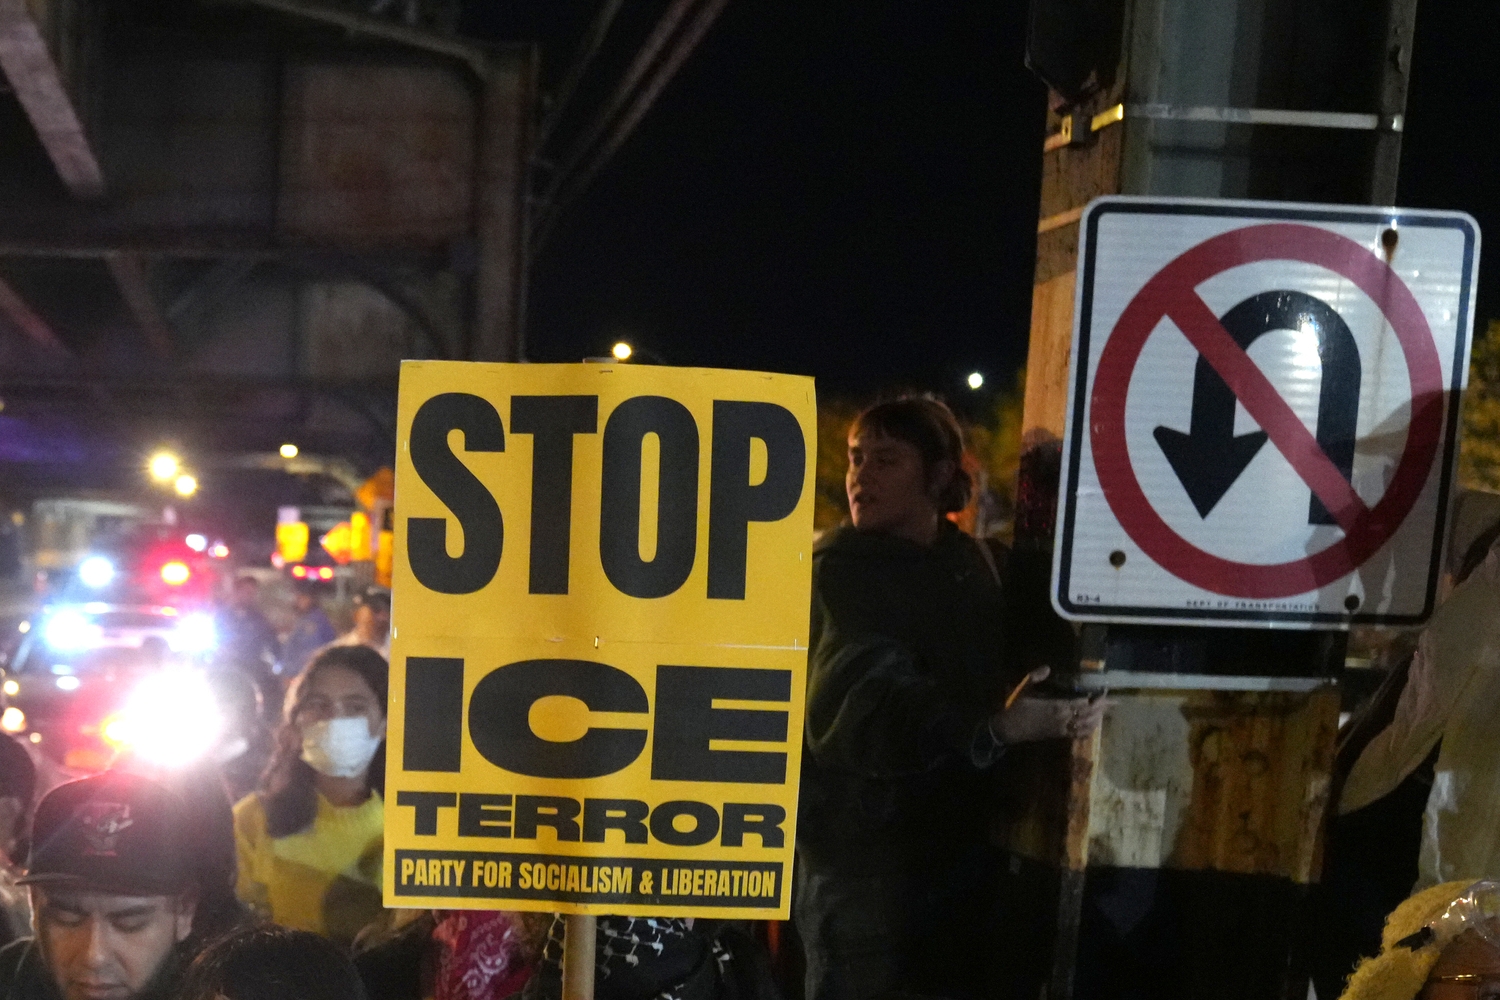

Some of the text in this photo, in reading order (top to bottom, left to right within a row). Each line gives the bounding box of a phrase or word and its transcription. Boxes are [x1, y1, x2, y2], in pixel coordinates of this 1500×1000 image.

[407, 392, 806, 600] STOP
[402, 656, 792, 784] ICE
[397, 790, 787, 848] TERROR
[401, 859, 776, 898] PARTY FOR SOCIALISM & LIBERATION
